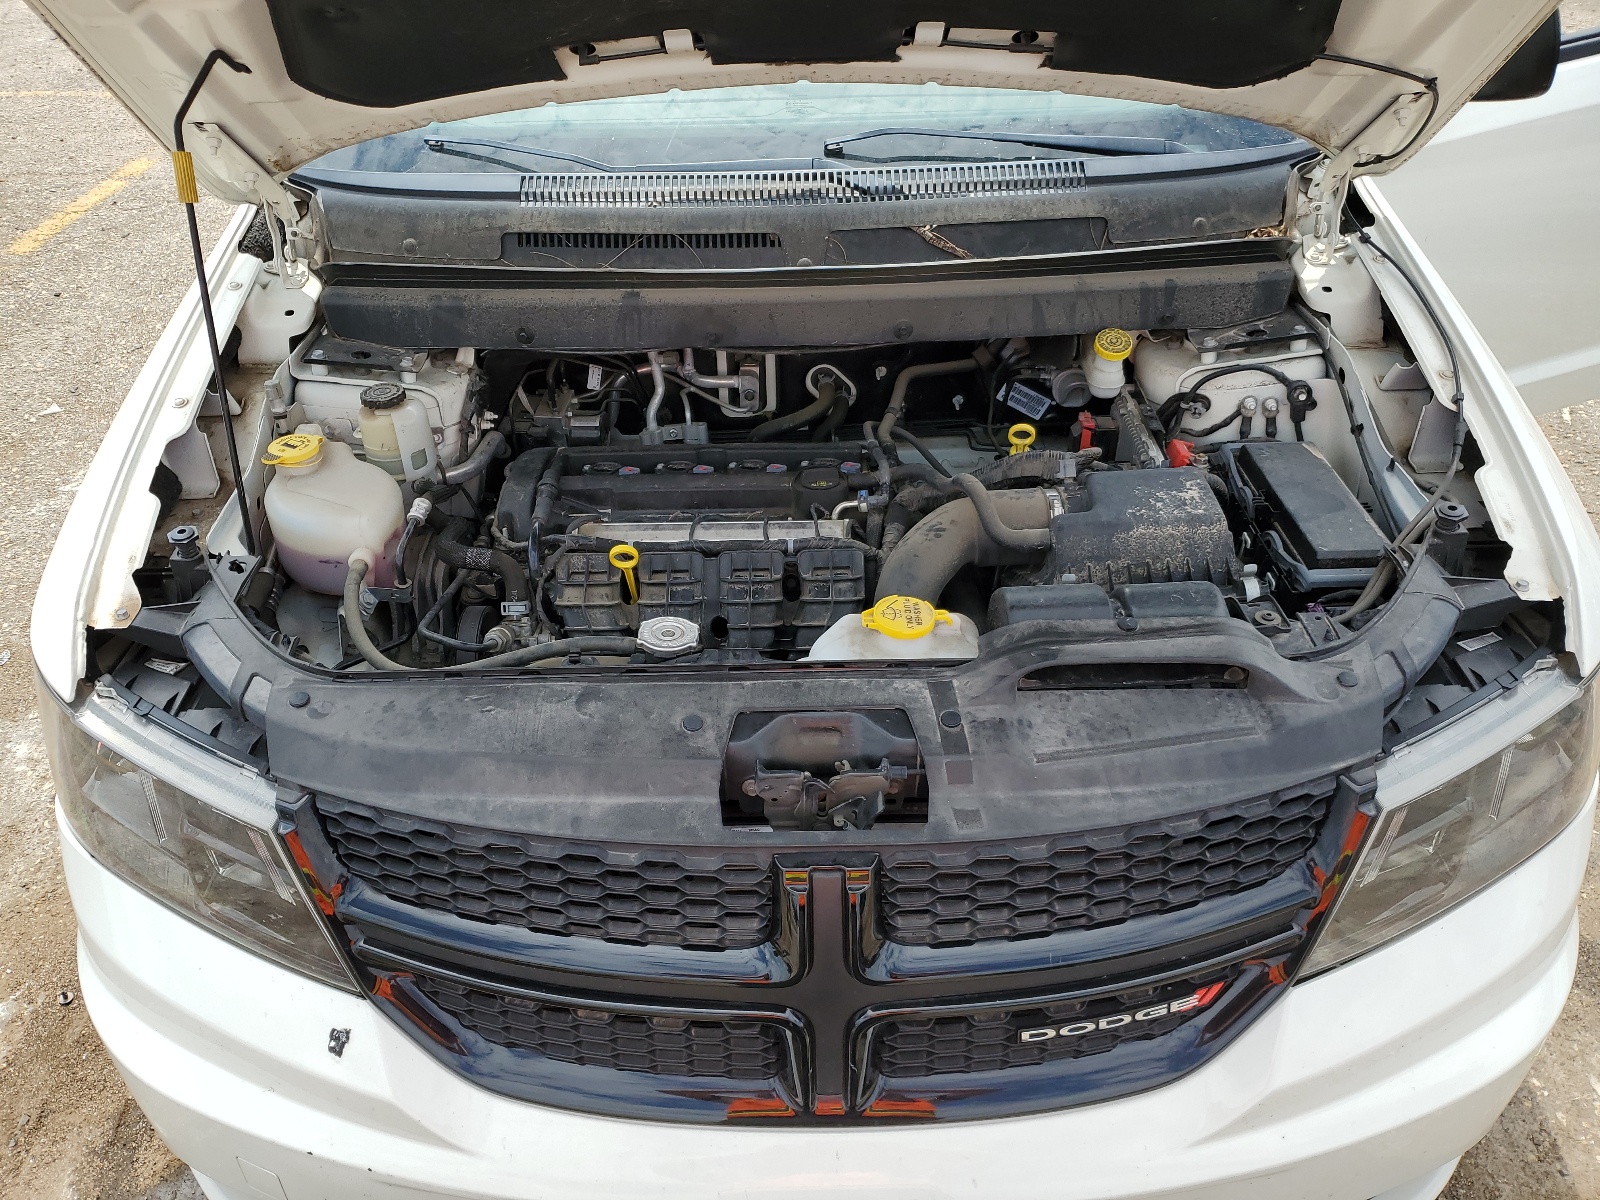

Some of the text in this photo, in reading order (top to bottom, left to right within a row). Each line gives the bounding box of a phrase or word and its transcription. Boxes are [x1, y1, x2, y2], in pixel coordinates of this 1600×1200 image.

[905, 614, 915, 630] ONLY
[912, 601, 923, 626] WASHER
[1020, 994, 1200, 1043] DODGE
